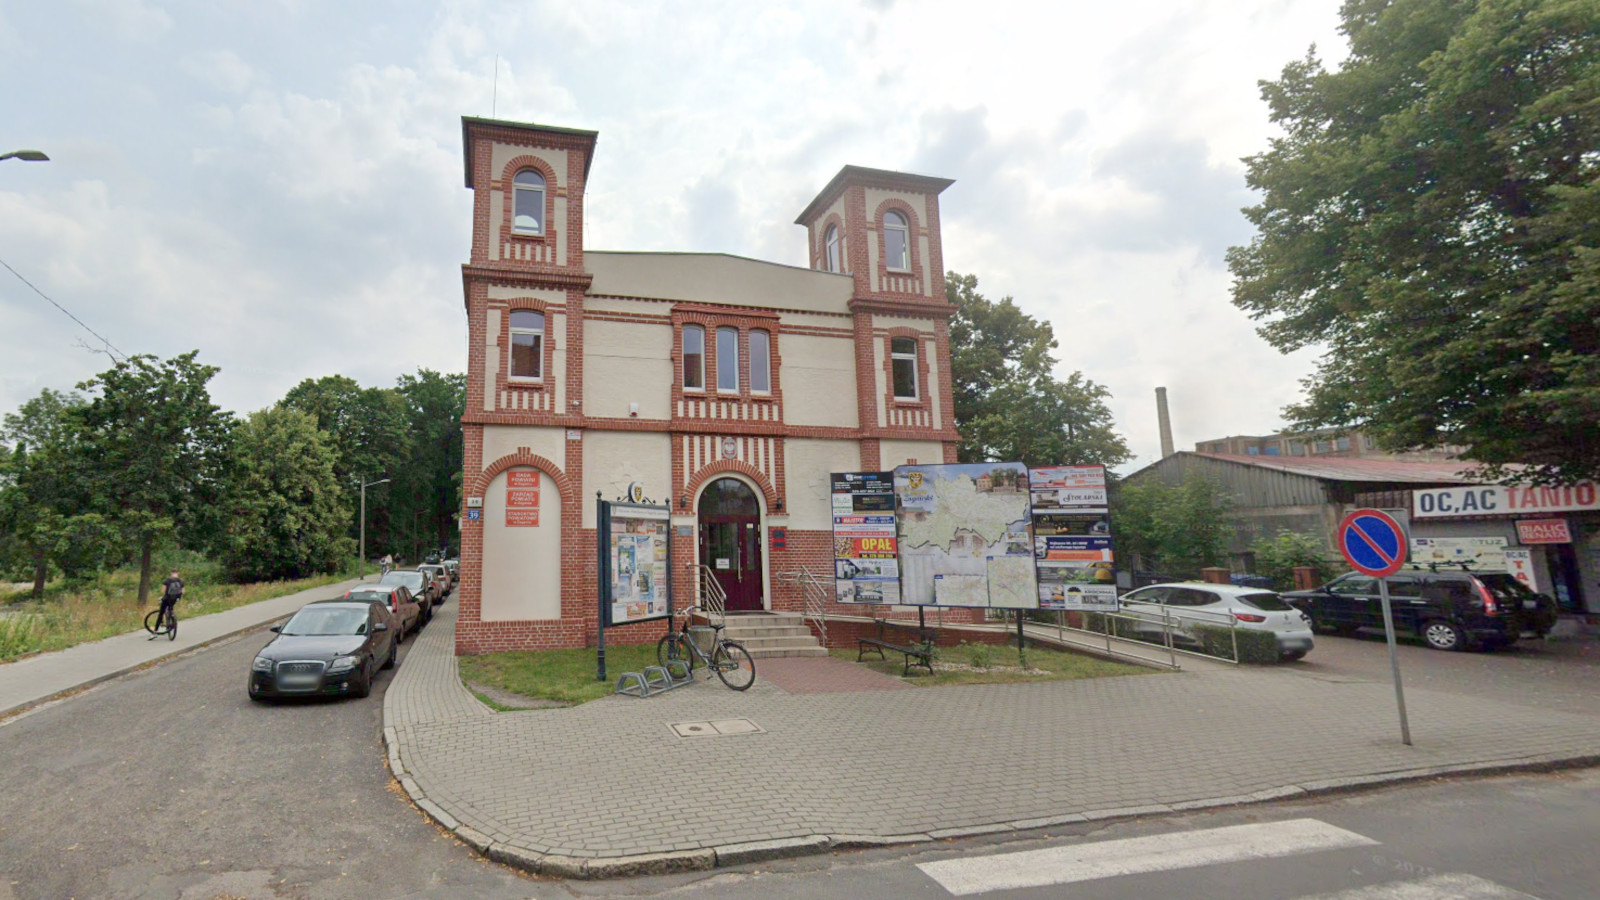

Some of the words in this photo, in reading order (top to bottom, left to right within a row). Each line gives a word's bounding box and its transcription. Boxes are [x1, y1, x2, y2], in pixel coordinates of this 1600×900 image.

[1420, 489, 1496, 513] OC,AC
[1504, 480, 1596, 509] TANIO
[861, 538, 893, 551] OPAŁ
